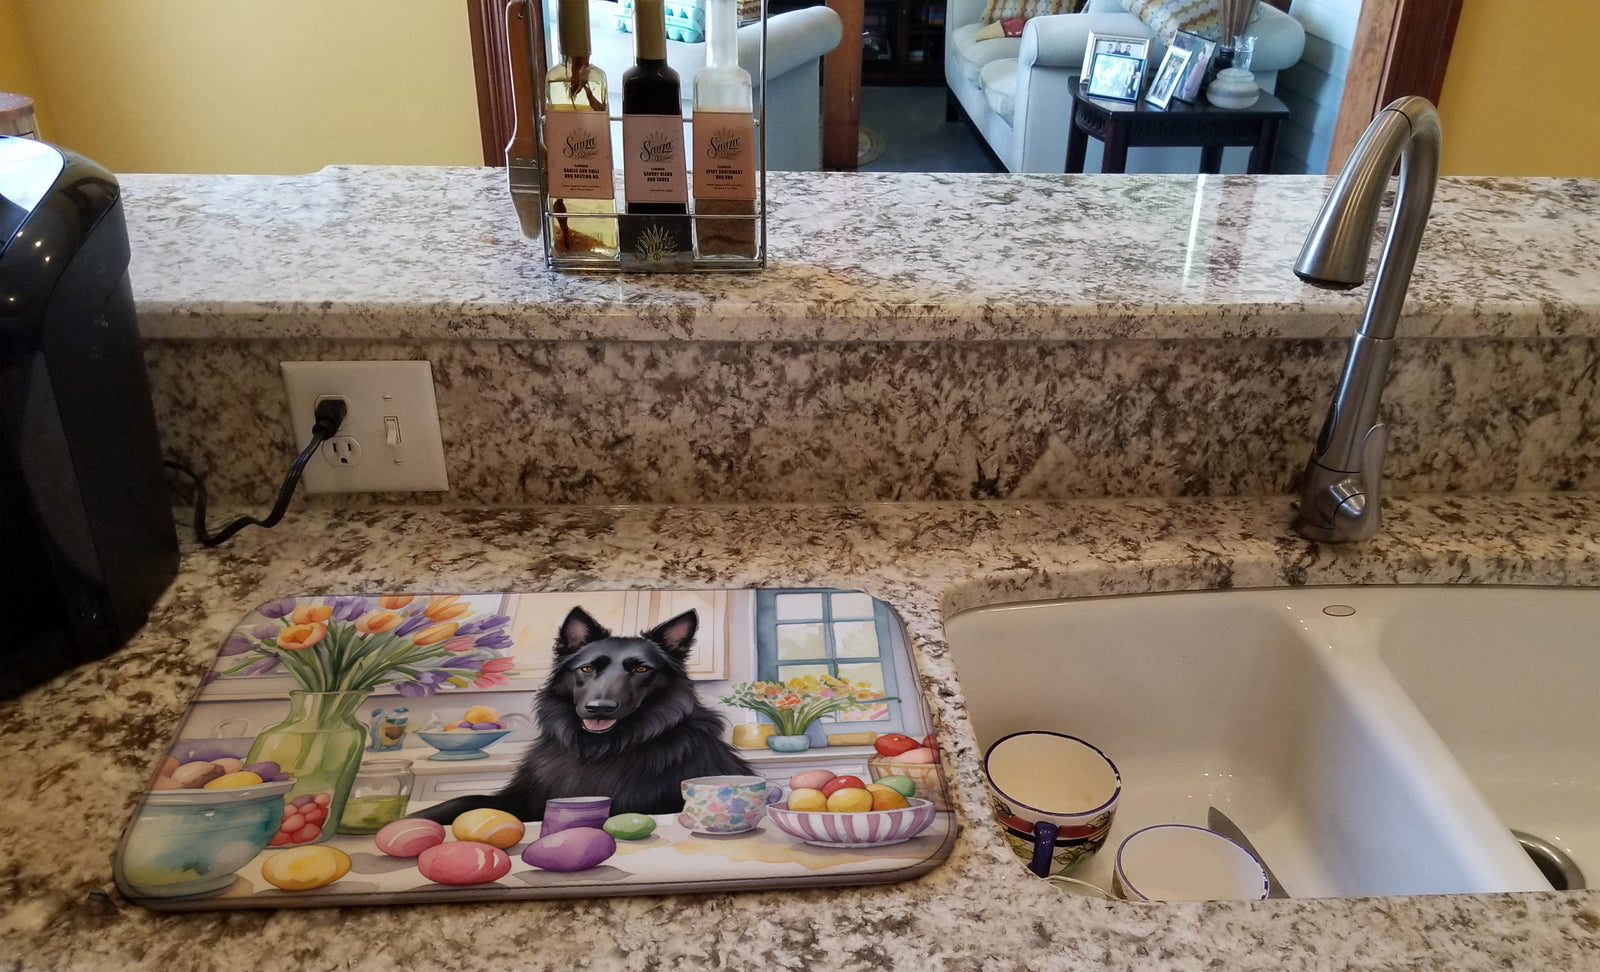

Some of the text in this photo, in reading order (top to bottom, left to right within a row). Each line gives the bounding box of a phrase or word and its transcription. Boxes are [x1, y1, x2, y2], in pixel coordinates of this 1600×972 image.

[563, 136, 598, 158] Sauza
[640, 140, 673, 162] Sauza
[707, 137, 740, 158] Sauza
